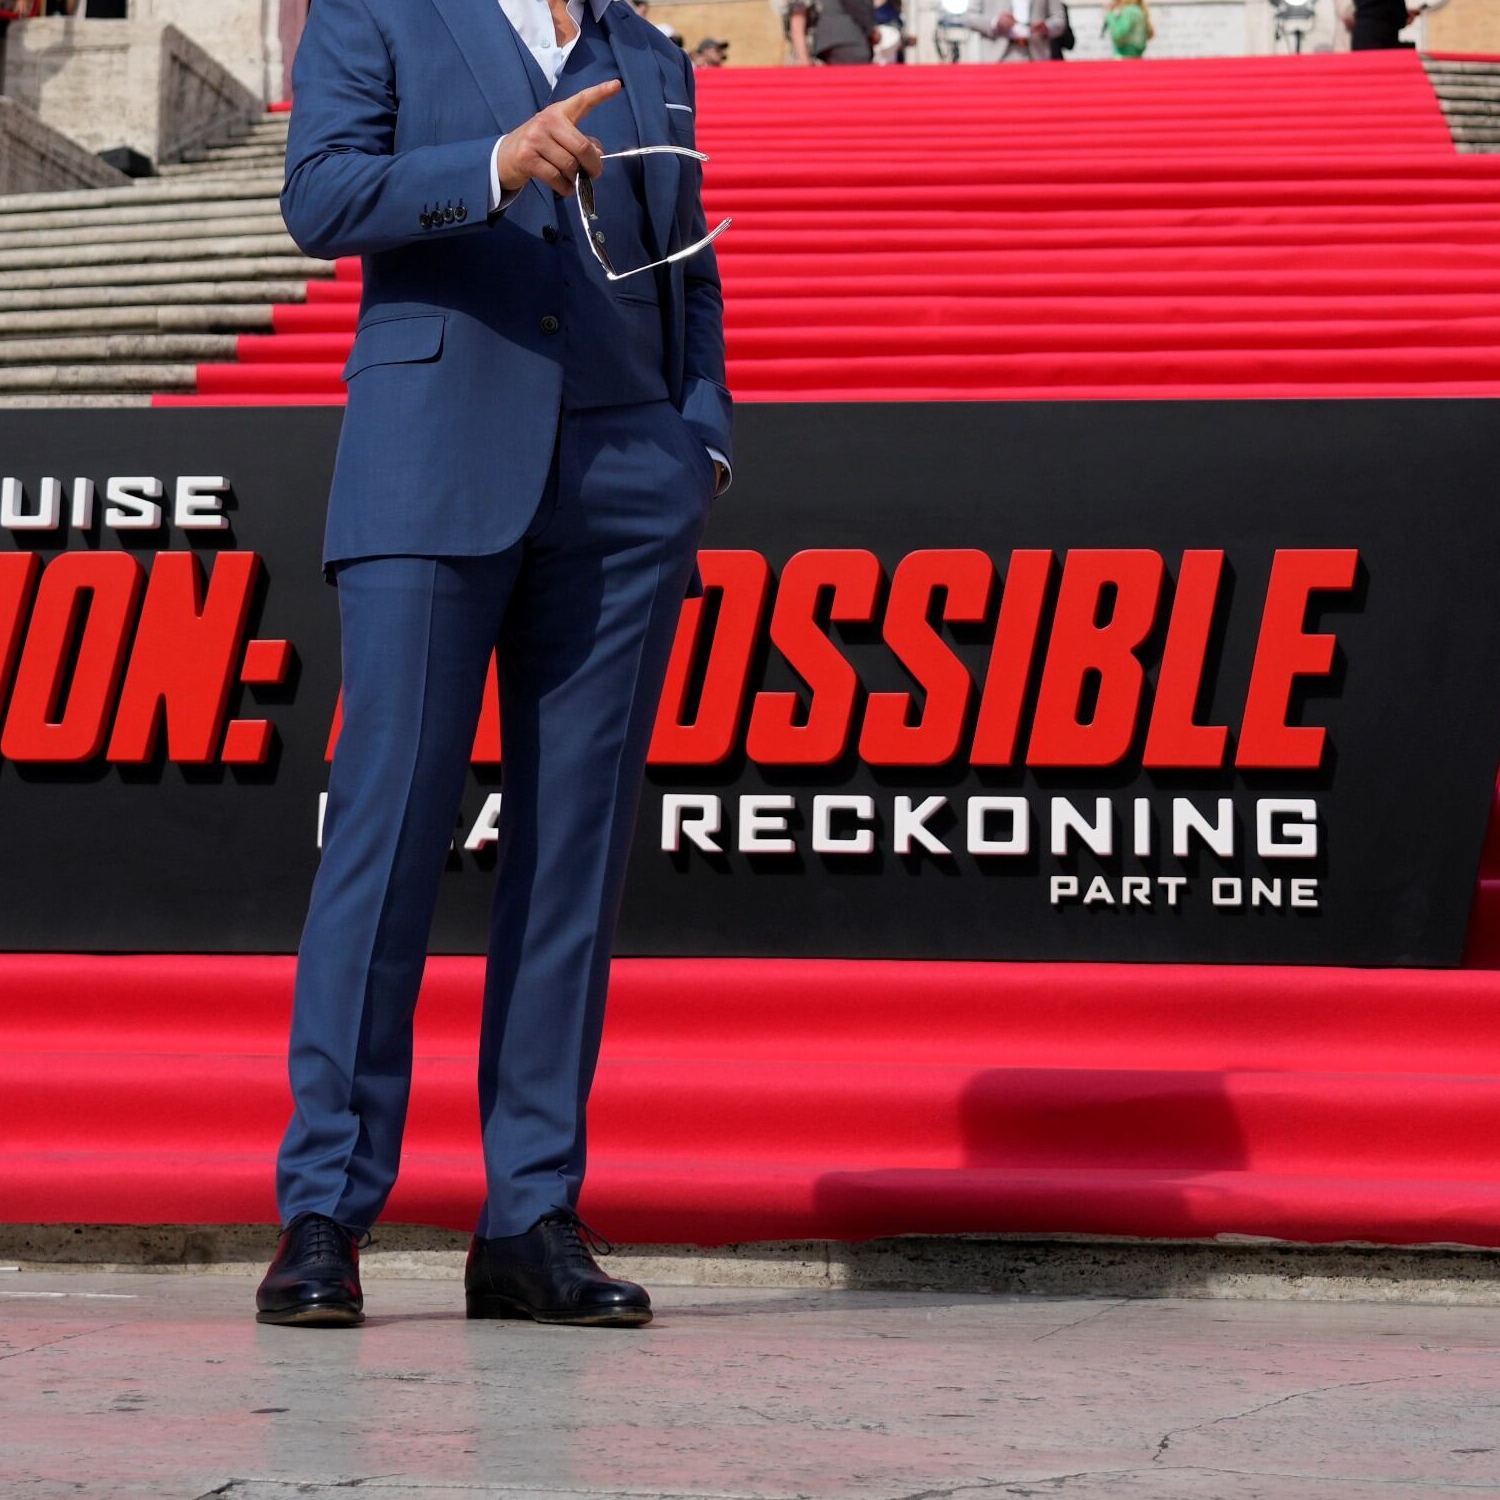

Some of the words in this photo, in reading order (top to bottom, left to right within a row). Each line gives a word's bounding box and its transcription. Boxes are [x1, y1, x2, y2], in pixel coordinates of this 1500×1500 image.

[325, 548, 1359, 770] OSSIBLE
[661, 794, 1318, 858] RECKONING
[1050, 875, 1187, 906] PART
[1212, 876, 1318, 908] ONE
